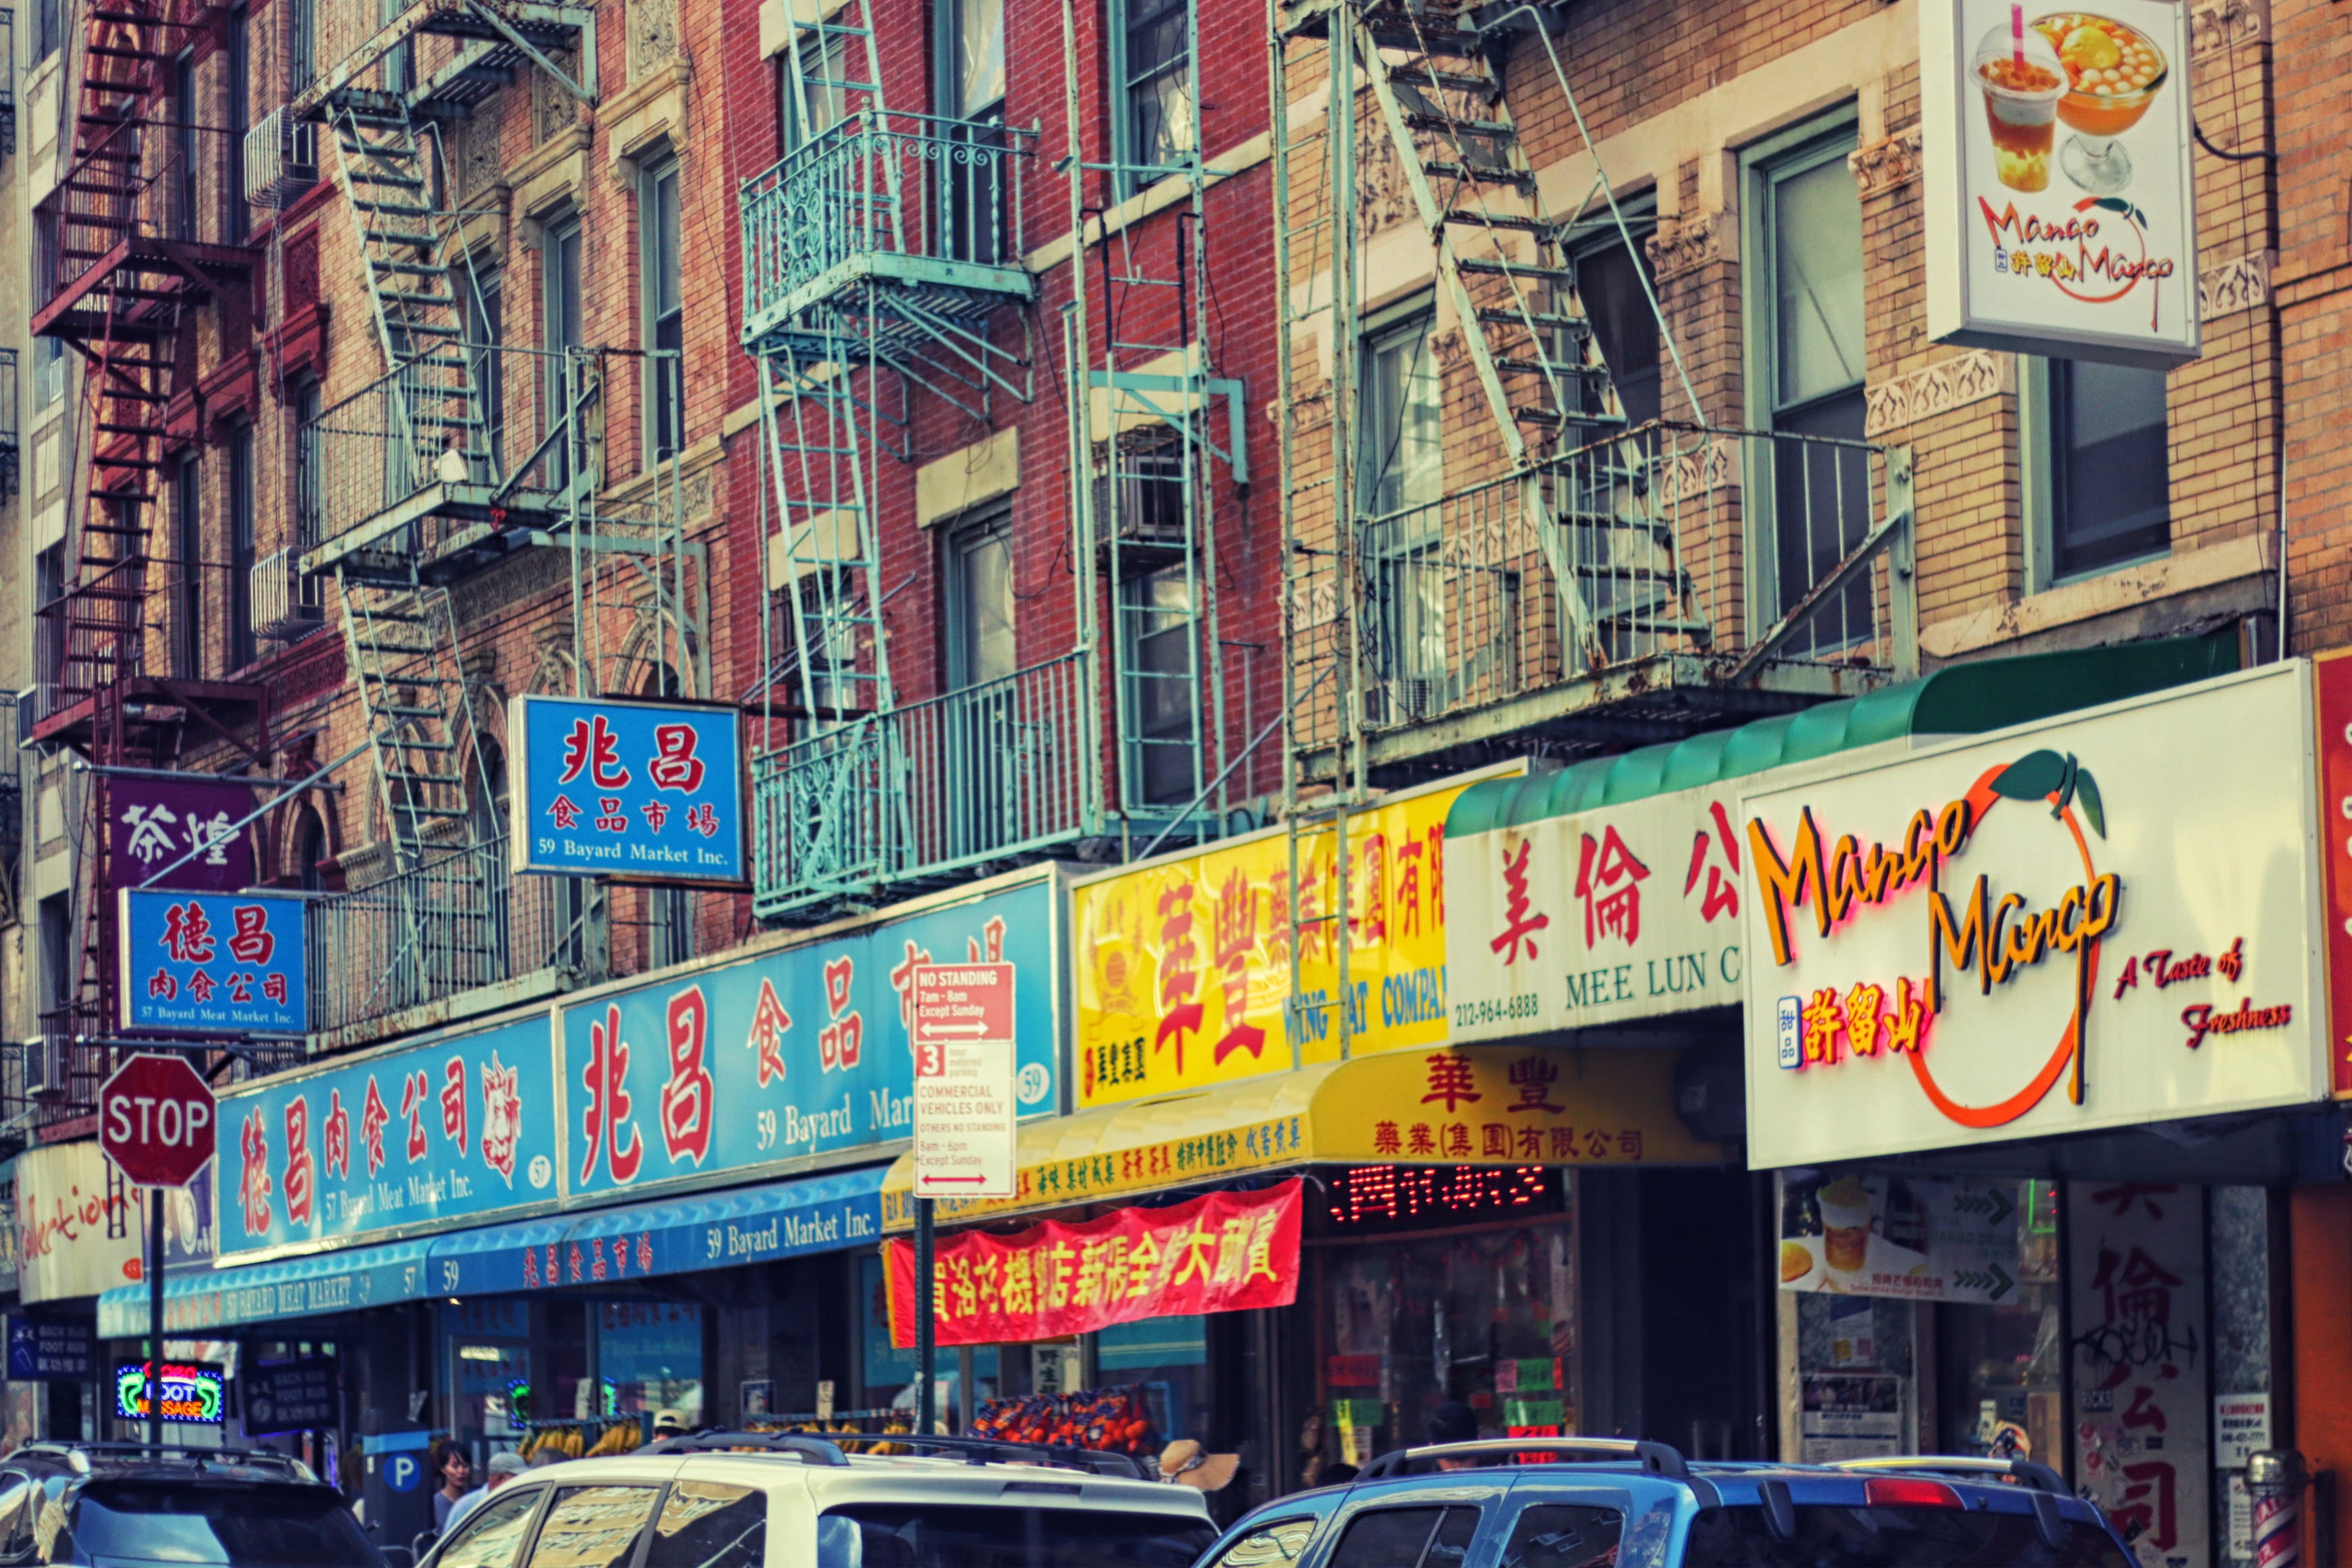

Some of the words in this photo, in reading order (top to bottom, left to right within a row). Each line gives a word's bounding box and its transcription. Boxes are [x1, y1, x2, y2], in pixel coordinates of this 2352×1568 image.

[1978, 196, 2099, 247] Mango
[559, 714, 705, 794] 兆昌
[545, 793, 719, 838] 食品市場
[539, 839, 556, 854] 59
[564, 839, 621, 861] Bayard
[631, 844, 689, 863] Market
[697, 848, 728, 865] Inc.
[1490, 801, 1739, 966] 美倫公
[1746, 799, 1971, 966] Mango
[160, 901, 274, 964] 德昌
[919, 973, 936, 987] NO
[939, 971, 998, 986] STANDING
[1565, 964, 1634, 1010] MEE
[1648, 951, 1707, 997] LUN
[2113, 956, 2138, 1000] A
[2142, 950, 2211, 988] Taste
[2217, 936, 2243, 983] of
[149, 969, 287, 1006] 肉食公司
[919, 991, 939, 1003] 7am
[947, 991, 966, 1002] 8am
[1929, 873, 2120, 1105] Mango
[142, 1007, 153, 1019] 57
[158, 1007, 195, 1024] Bayard
[201, 1008, 226, 1021] Meat
[232, 1010, 269, 1023] Market
[274, 1012, 294, 1024] Inc.
[919, 1006, 950, 1020] Except
[952, 1004, 985, 1019] Sunday
[1339, 981, 1367, 1035] AT
[1456, 993, 1539, 1029] 212-964-6888
[1802, 977, 1925, 1064] 許留山
[2181, 997, 2292, 1050] Freshness
[922, 1046, 939, 1075] 3
[949, 1047, 966, 1056] hour
[949, 1057, 981, 1068] metered
[949, 1068, 977, 1079] parking
[1023, 1067, 1042, 1098] 59
[1421, 1052, 1566, 1114] 華豐
[920, 1085, 993, 1099] COMMERCIAL
[920, 1102, 973, 1115] VEHICLES
[975, 1101, 1004, 1114] ONLY
[107, 1095, 208, 1147] STOP
[757, 1110, 777, 1150] 59
[784, 1094, 852, 1153] Bayard
[870, 1087, 914, 1131] Mar
[920, 1123, 951, 1133] OTHERS
[953, 1123, 964, 1132] NO
[966, 1123, 1006, 1132] STANDING
[238, 1054, 468, 1236] 德昌肉食公司
[920, 1141, 940, 1152] 8am
[947, 1140, 967, 1153] 6pm
[920, 1155, 949, 1167] Except
[951, 1154, 983, 1167] Sunday
[534, 1161, 545, 1183] 57
[326, 1192, 336, 1221] 57
[378, 1182, 403, 1211] Meat
[408, 1173, 446, 1206] Market
[451, 1169, 473, 1199] Inc.
[708, 1229, 722, 1258] 59
[729, 1219, 777, 1262] Bayard
[785, 1211, 837, 1247] Market
[846, 1207, 875, 1238] Inc.
[443, 1260, 459, 1292] 59
[240, 1289, 275, 1318] BAYARD
[278, 1285, 305, 1314] MEAT
[308, 1276, 351, 1309] MARKET
[137, 1398, 203, 1417] MSAGE
[395, 1461, 414, 1486] P
